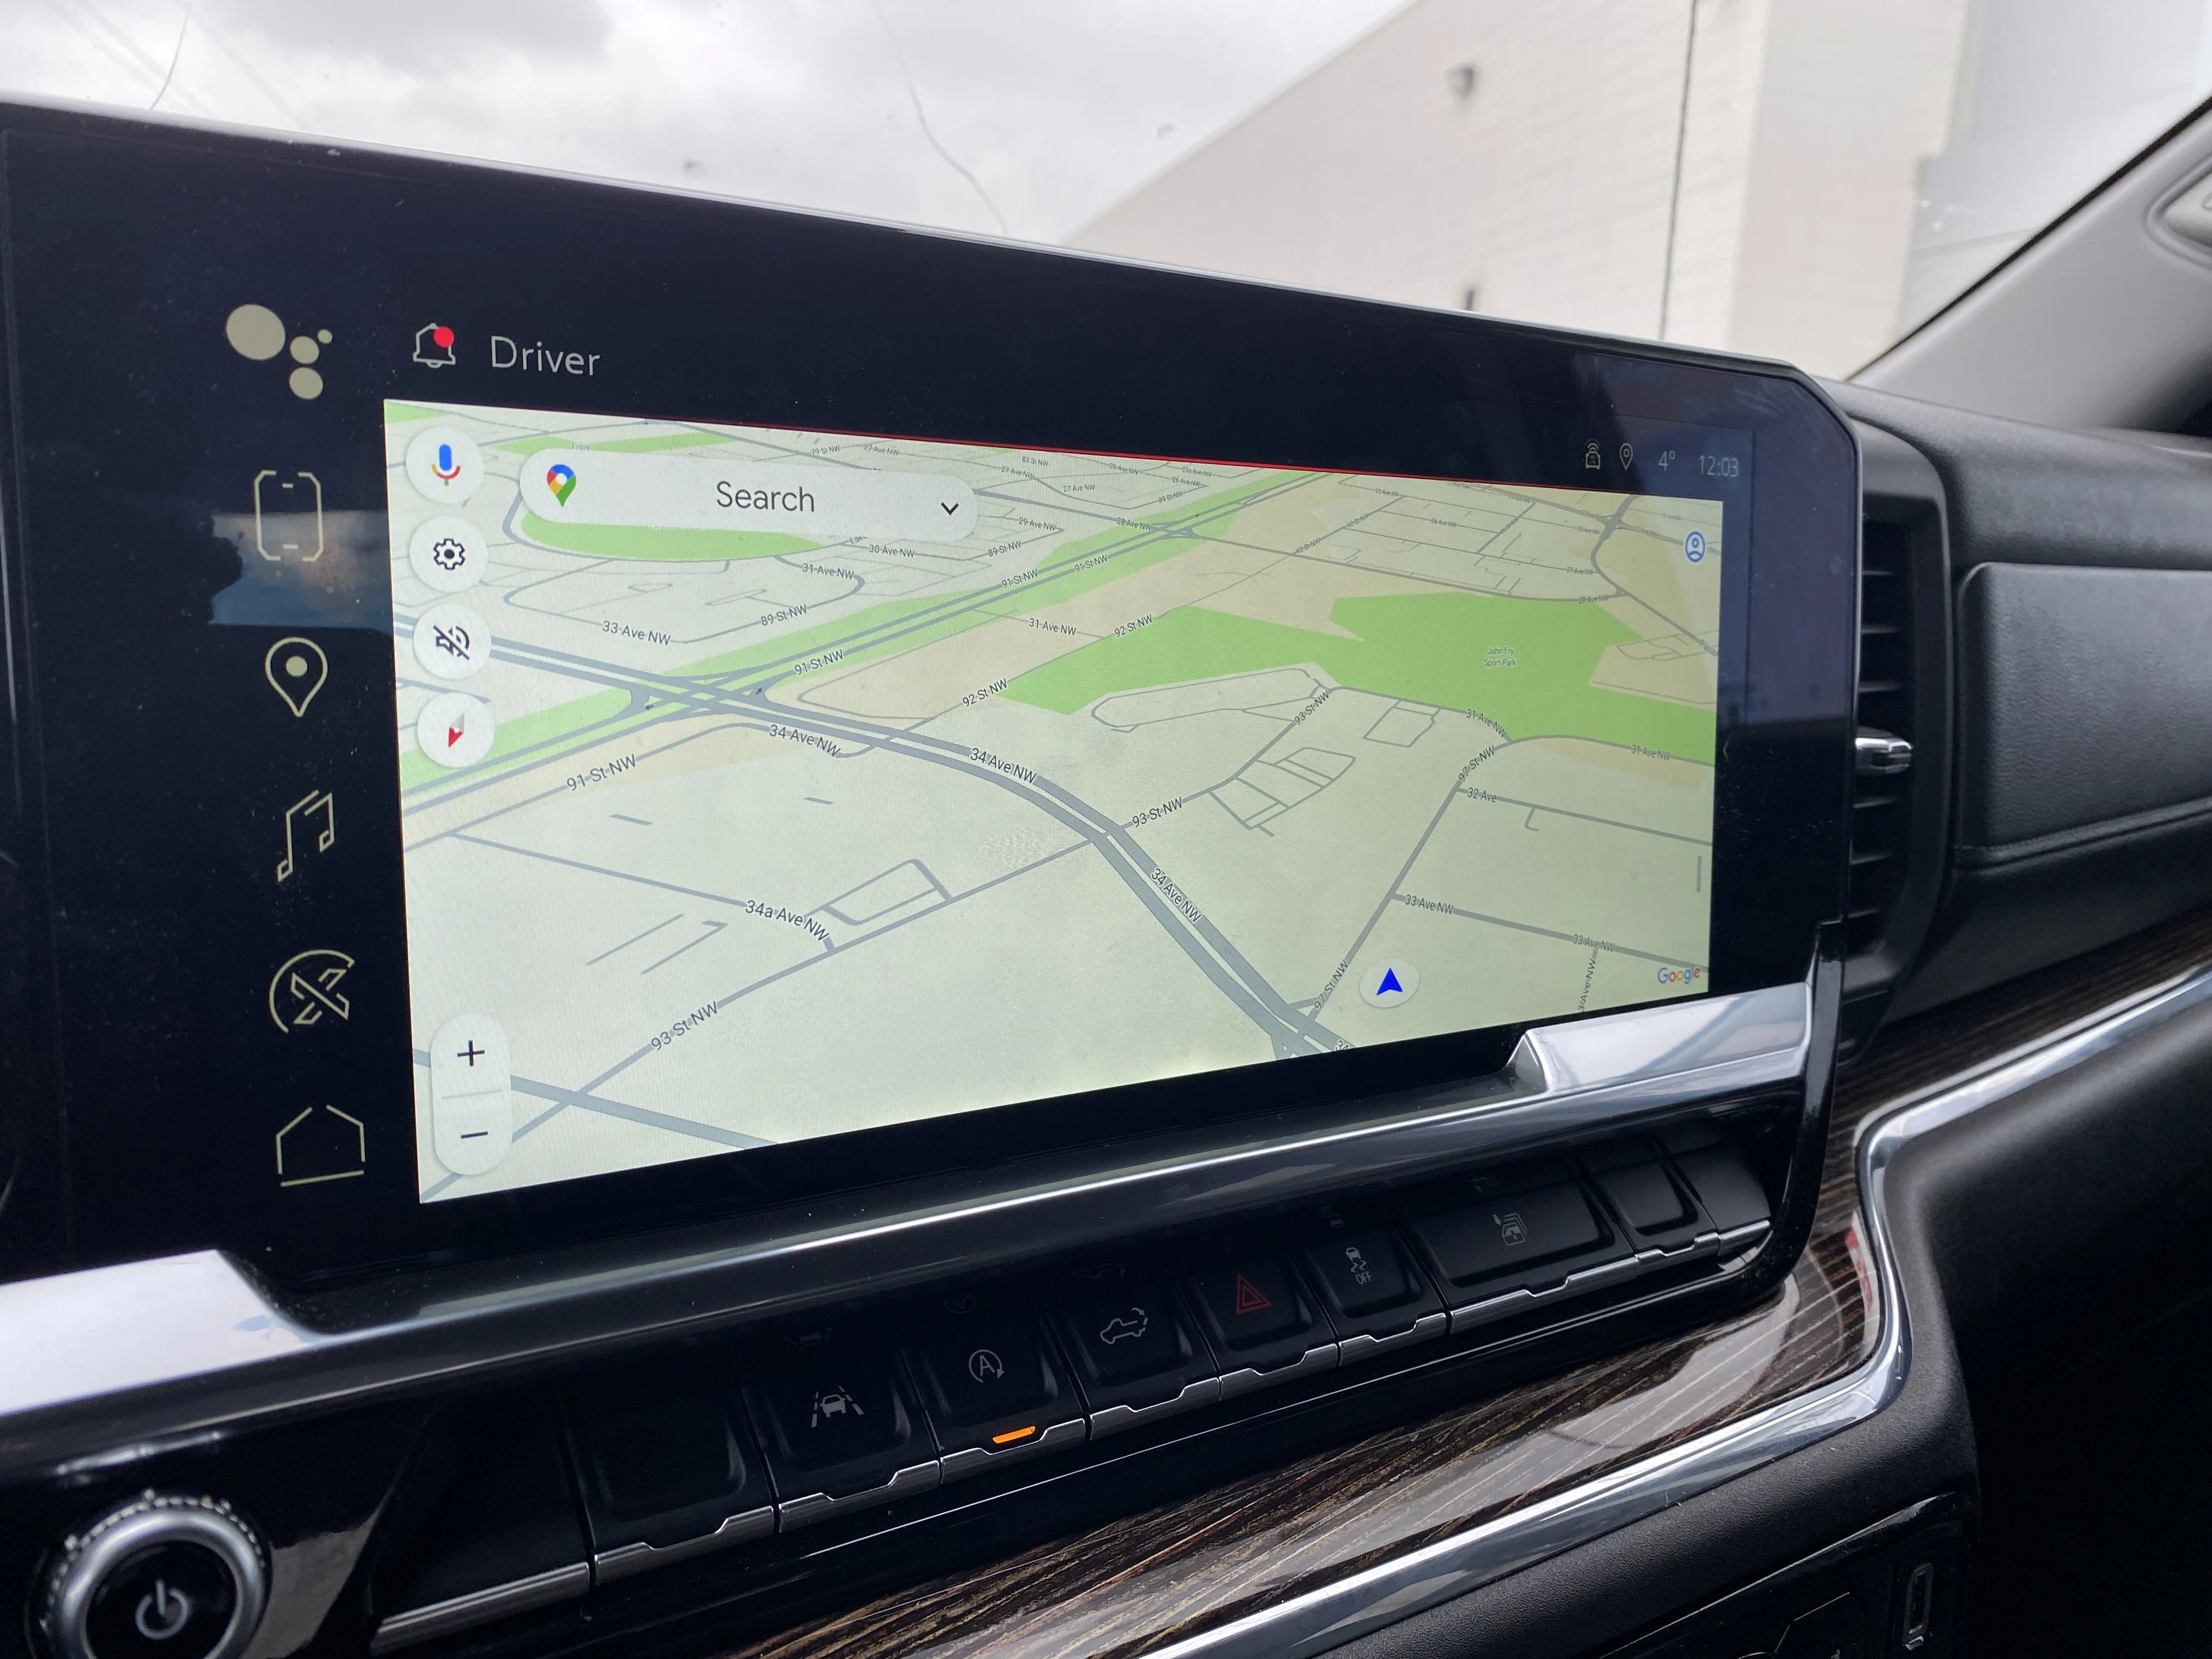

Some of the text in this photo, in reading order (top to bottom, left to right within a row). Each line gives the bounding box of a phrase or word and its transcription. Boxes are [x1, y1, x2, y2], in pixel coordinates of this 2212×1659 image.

[491, 335, 600, 376] Driver
[887, 448, 899, 456] NW
[1010, 467, 1022, 476] Ave
[1023, 470, 1034, 479] NW
[1699, 455, 1739, 477] 12:03
[716, 481, 816, 512] Search
[1173, 490, 1183, 499] NW
[1029, 520, 1042, 528] Ave
[1043, 522, 1056, 531] NW
[1140, 522, 1152, 531] NW
[1359, 513, 1369, 523] NW
[869, 545, 915, 558] 30 Ave NW
[988, 540, 1022, 557] 89 St NW
[1296, 537, 1321, 554] 92 St NW
[802, 563, 854, 580] 31 Ave NW
[1075, 554, 1108, 572] 91 St NW
[1002, 568, 1038, 589] 91 St NW
[761, 605, 808, 627] 89 St NW
[1029, 618, 1076, 635] 31 Ave NW
[1115, 614, 1153, 637] 92 St NW
[602, 620, 672, 646] 33 Ave NW
[794, 649, 844, 675] 91 St NW
[1484, 659, 1501, 668] Sport
[963, 678, 1007, 707] 92 St NW
[1295, 690, 1329, 725] 93 St NW
[1466, 709, 1507, 738] 31 Ave NW
[769, 725, 840, 757] 34 Ave NW
[1631, 744, 1671, 760] 31 Ave NW
[567, 754, 637, 791] 91 St NW
[970, 747, 1037, 784] 34 Ave NW
[1458, 744, 1494, 782] 97 St NW
[1467, 787, 1497, 803] 32 Ave
[1132, 796, 1183, 827] 93 St NW
[1151, 868, 1202, 923] 34 Ave NW
[1404, 894, 1454, 915] 33 Ave NW
[745, 900, 830, 942] 34a Ave NW
[1573, 934, 1615, 952] 33 Ave NW
[1585, 958, 1597, 980] NW
[1657, 963, 1701, 984] Google
[1314, 959, 1348, 1010] 97 St NW
[1581, 982, 1590, 1003] Ave
[651, 1001, 719, 1052] 93 St NW
[1356, 1271, 1372, 1284] OFF
